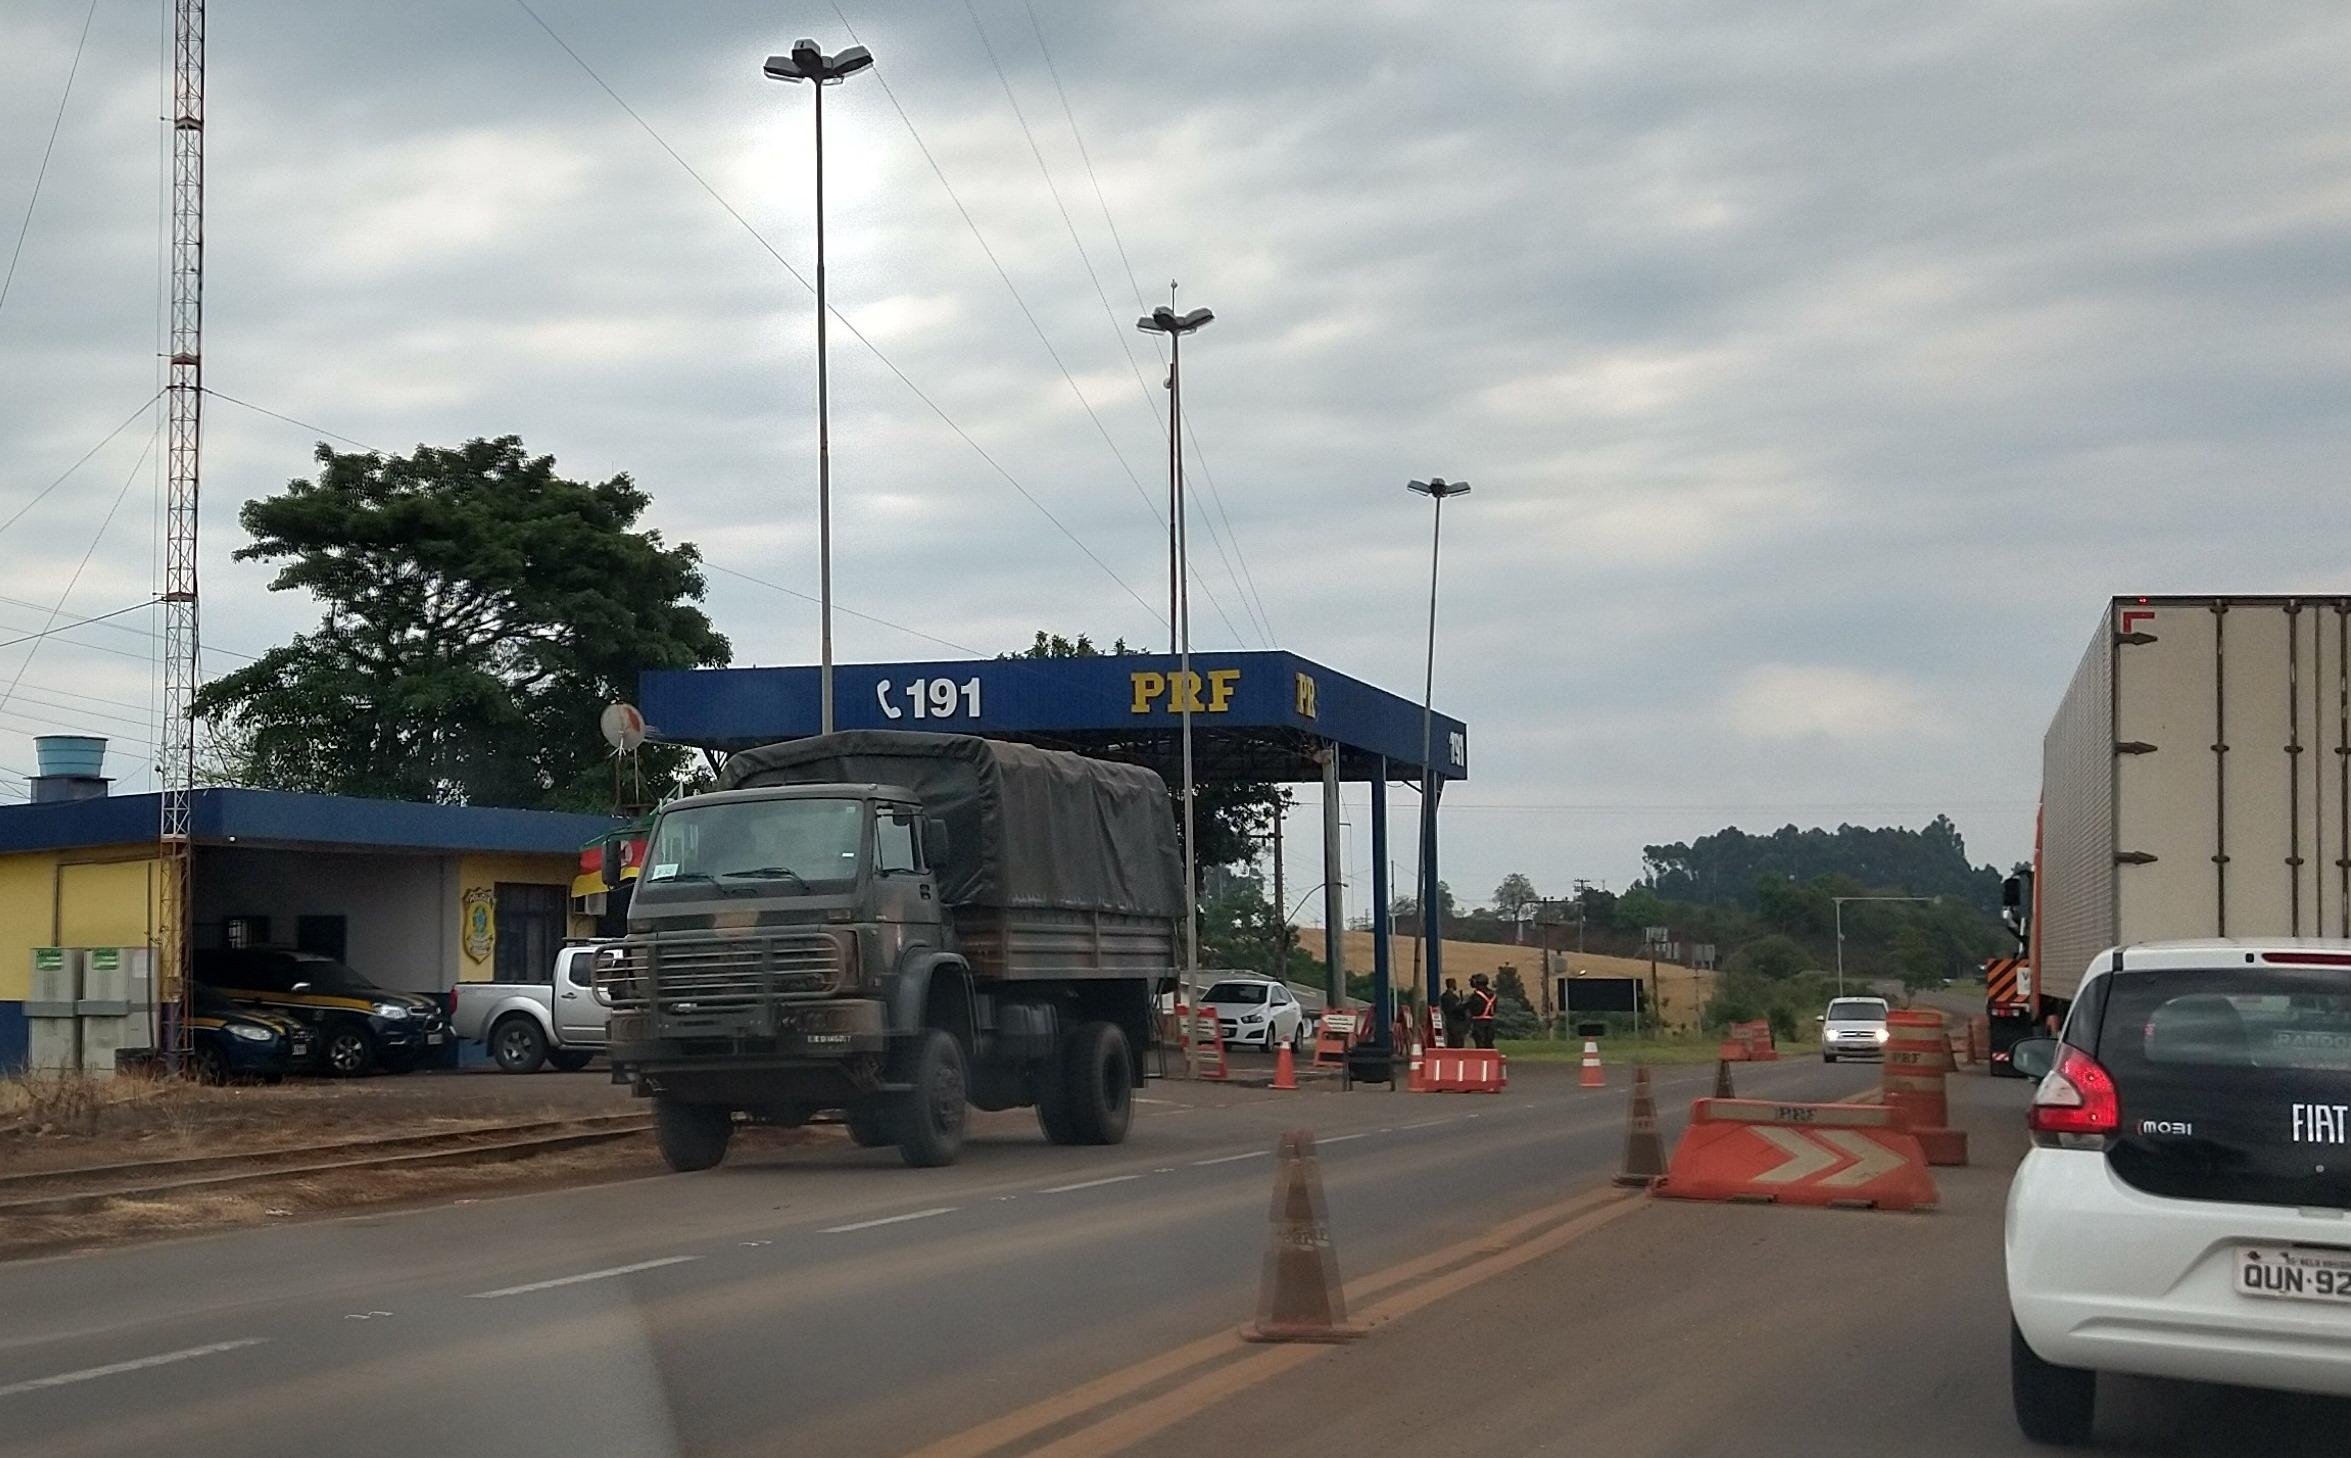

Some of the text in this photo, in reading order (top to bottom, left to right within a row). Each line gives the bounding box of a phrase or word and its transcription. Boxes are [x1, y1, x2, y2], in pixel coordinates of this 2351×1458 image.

[906, 677, 980, 718] 191
[1130, 669, 1241, 713] PRF
[2277, 1034, 2351, 1049] RANDO
[2292, 1103, 2349, 1144] FIAT
